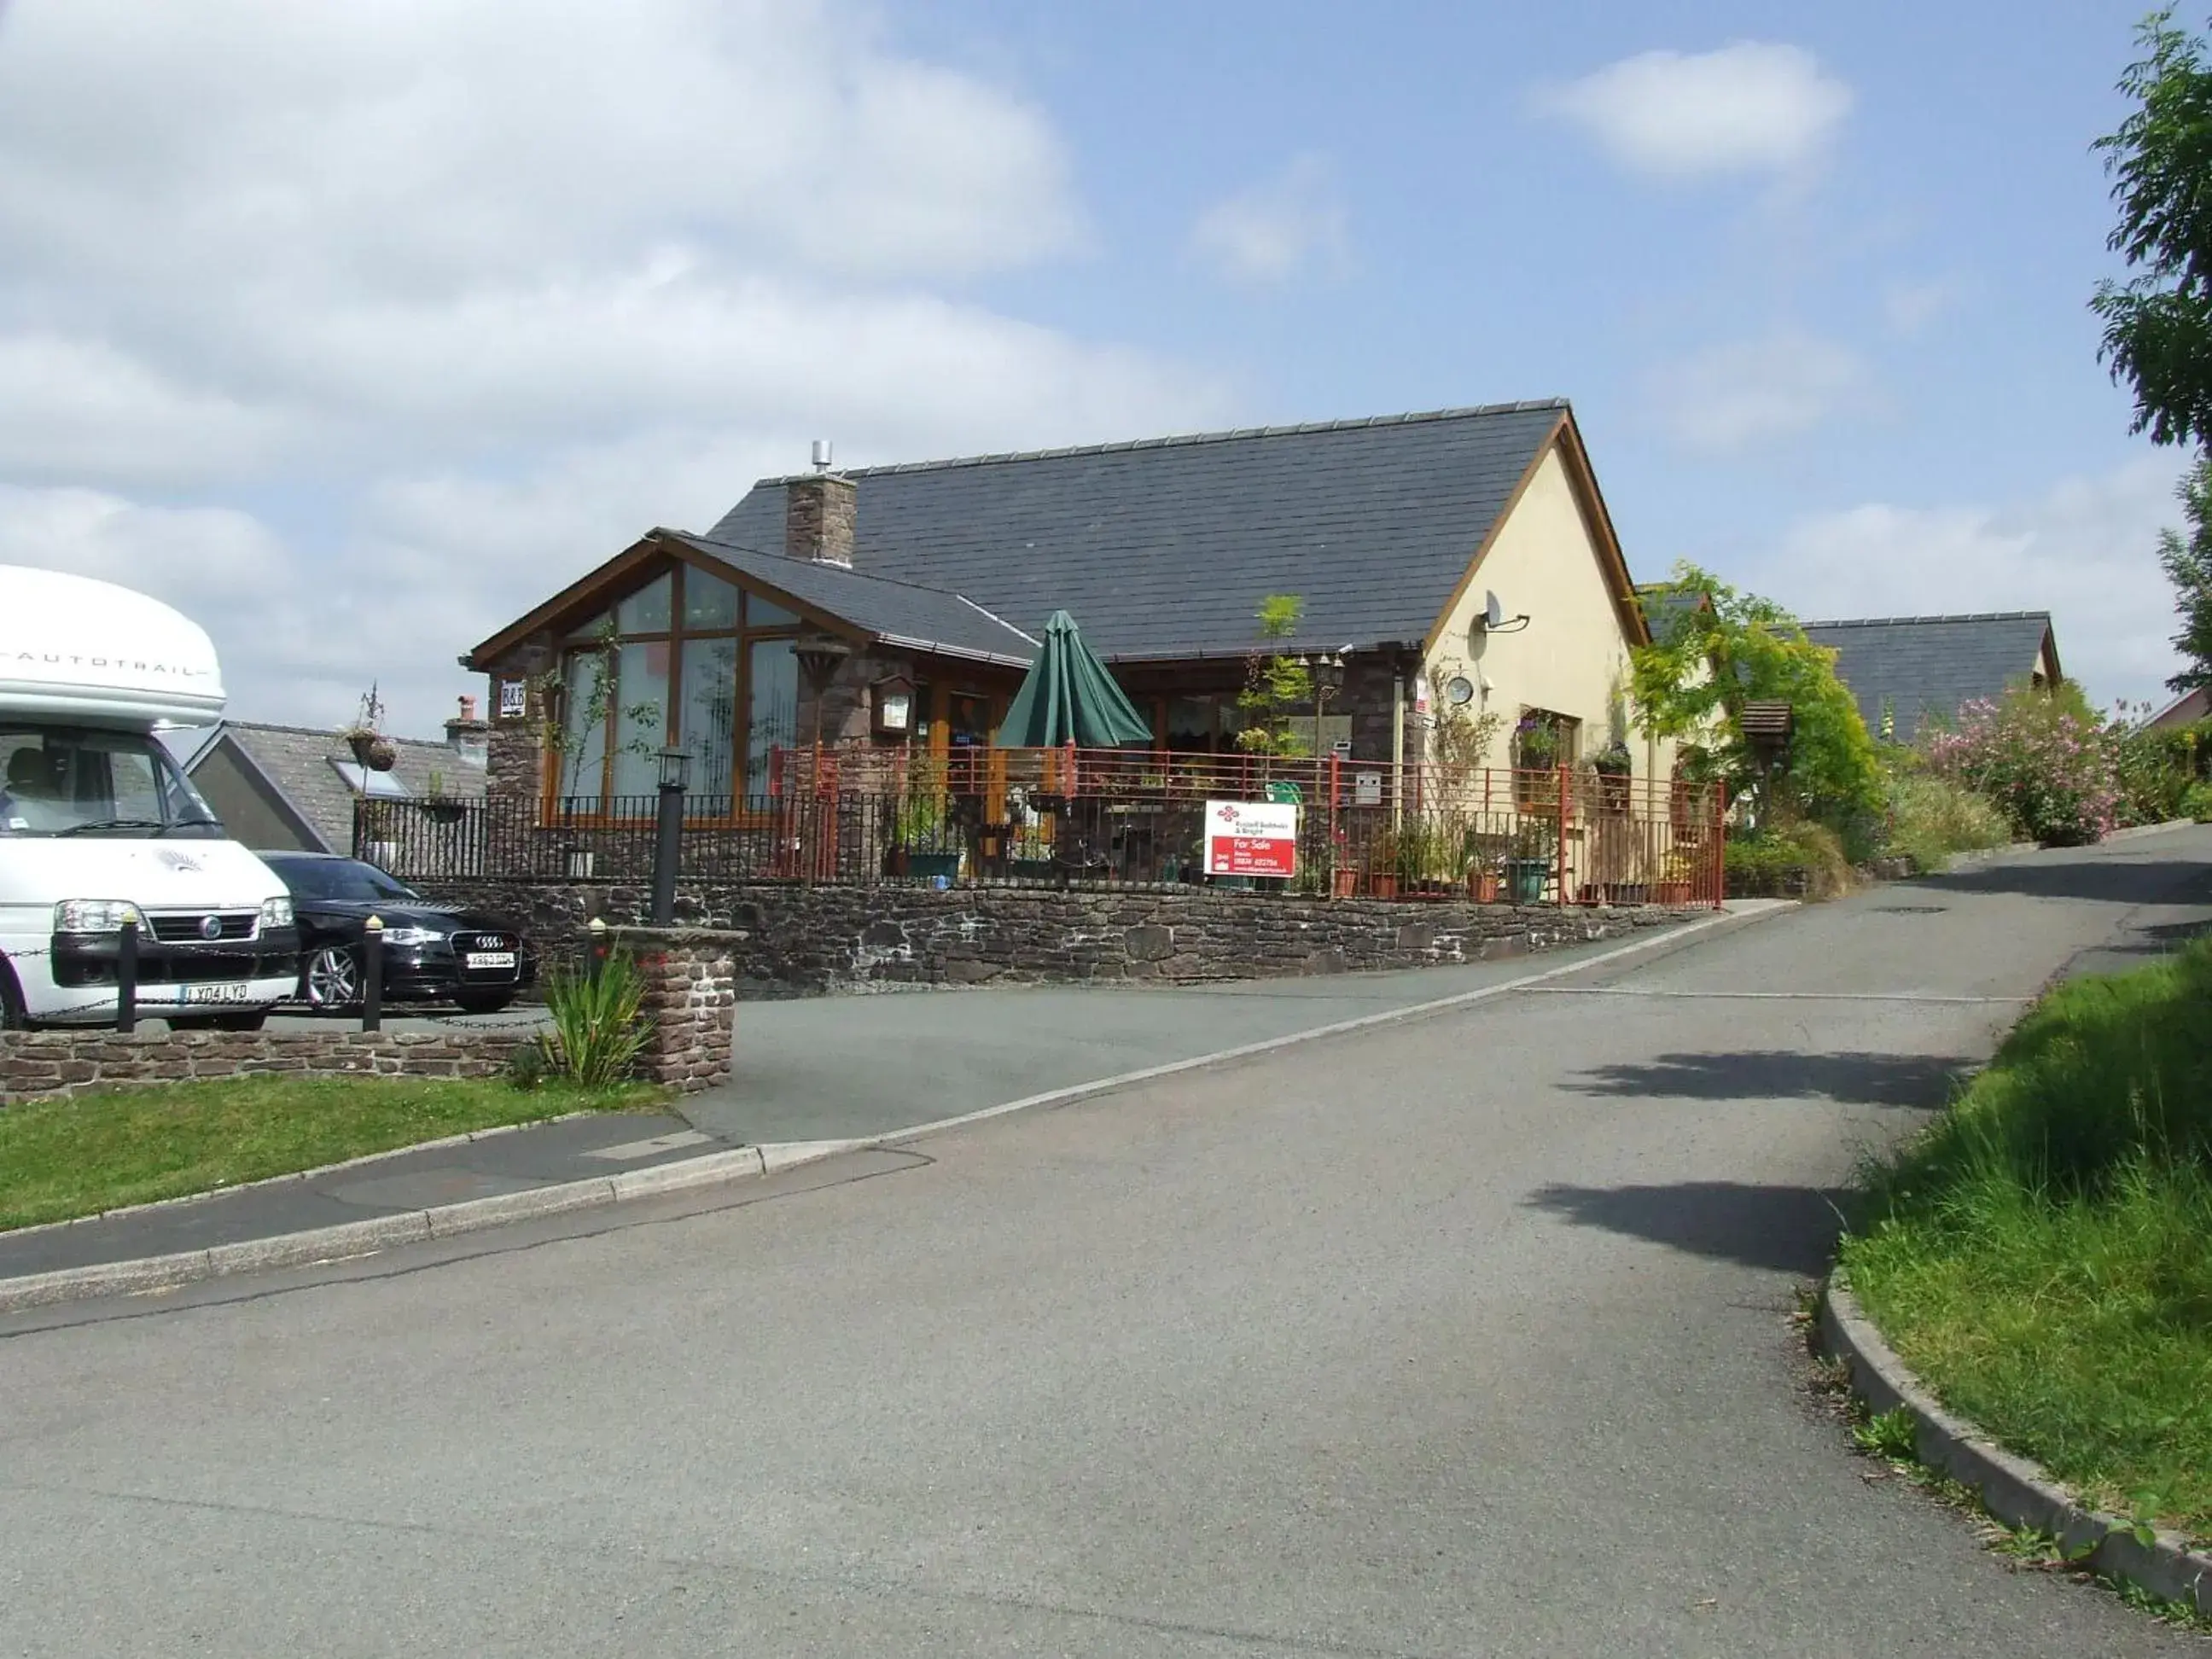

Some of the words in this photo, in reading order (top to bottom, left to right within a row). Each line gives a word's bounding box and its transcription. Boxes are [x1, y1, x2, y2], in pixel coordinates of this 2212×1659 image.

[17, 651, 195, 677] AUTOTRAIL
[503, 687, 524, 707] B&B
[1234, 839, 1248, 848] For
[1250, 839, 1271, 850] Sale
